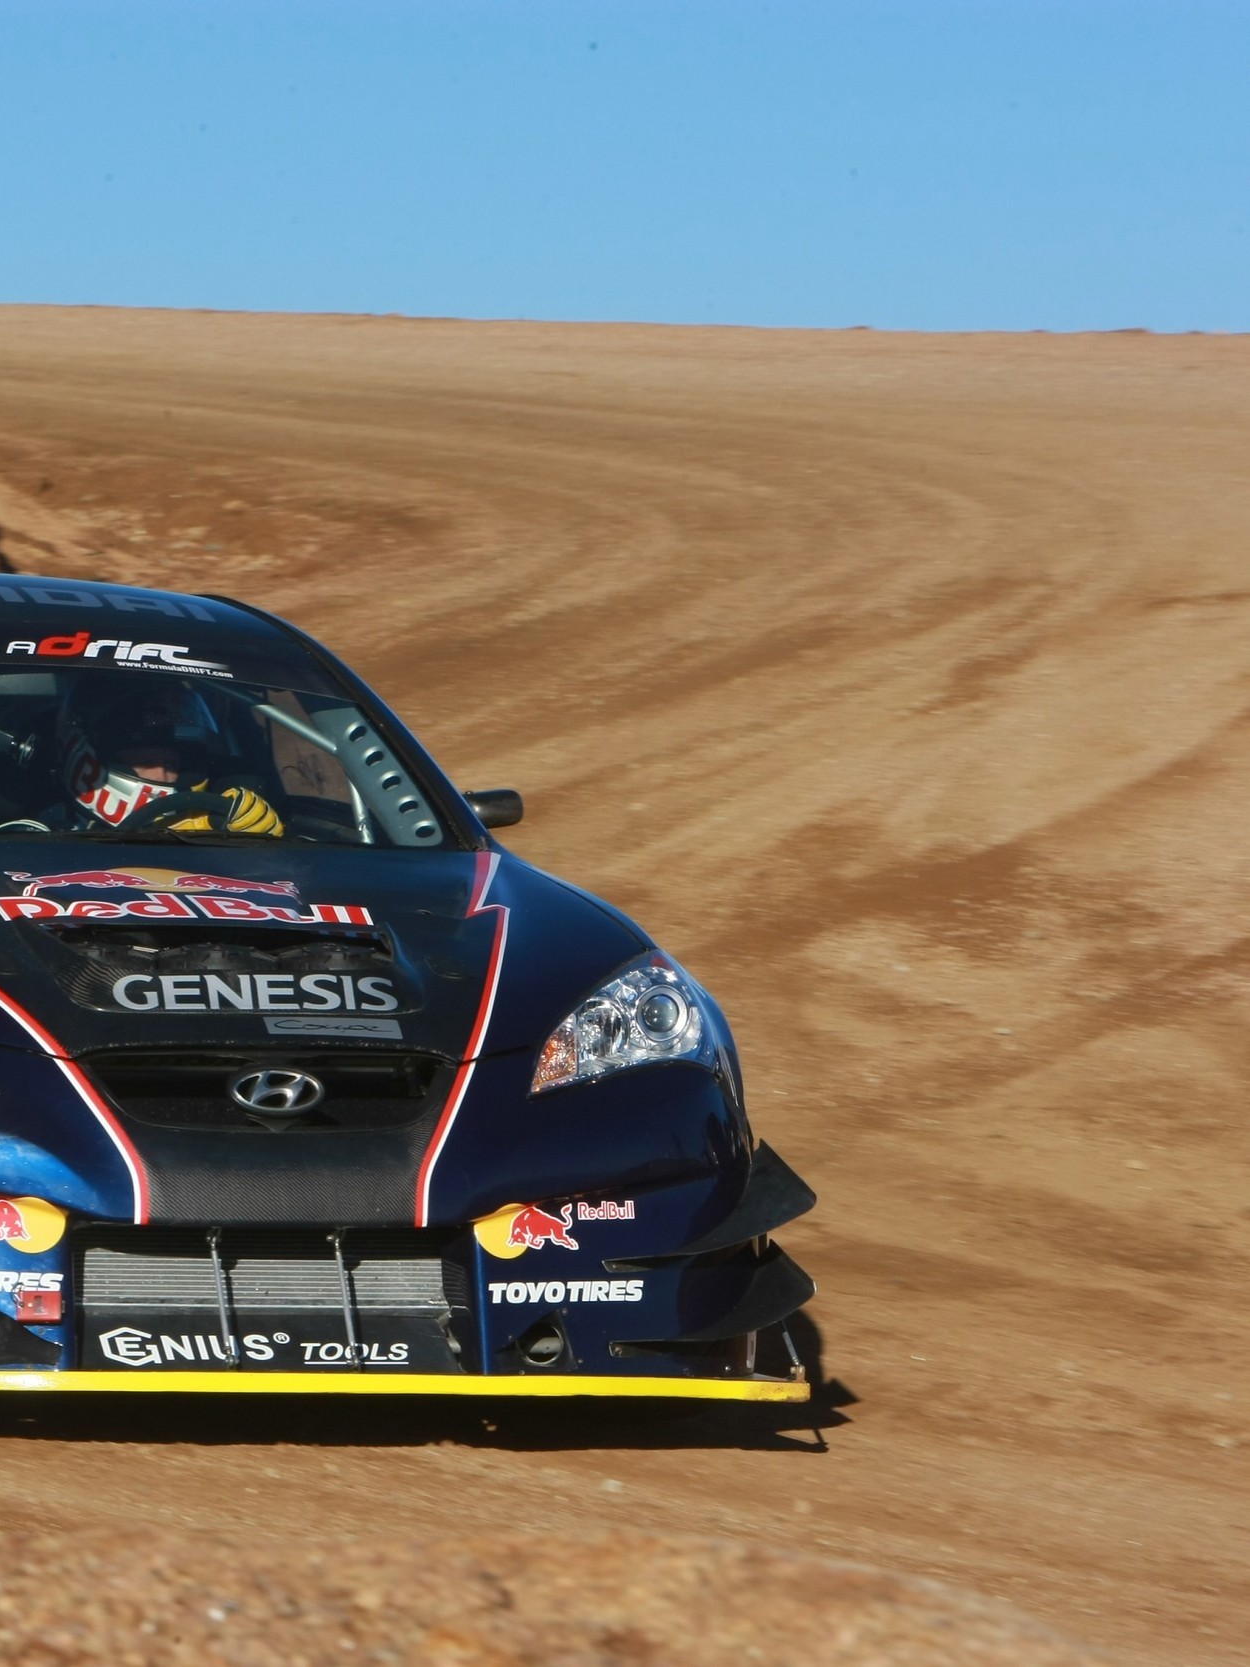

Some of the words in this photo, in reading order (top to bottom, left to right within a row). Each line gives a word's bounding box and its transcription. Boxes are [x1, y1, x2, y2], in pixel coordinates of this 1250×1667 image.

[71, 752, 169, 824] Bul
[112, 973, 399, 1012] GENESIS
[577, 1201, 607, 1220] Red
[607, 1200, 636, 1220] Bull
[488, 1281, 566, 1304] TOYO
[567, 1280, 644, 1302] TIRES
[300, 1342, 410, 1361] TOOLS
